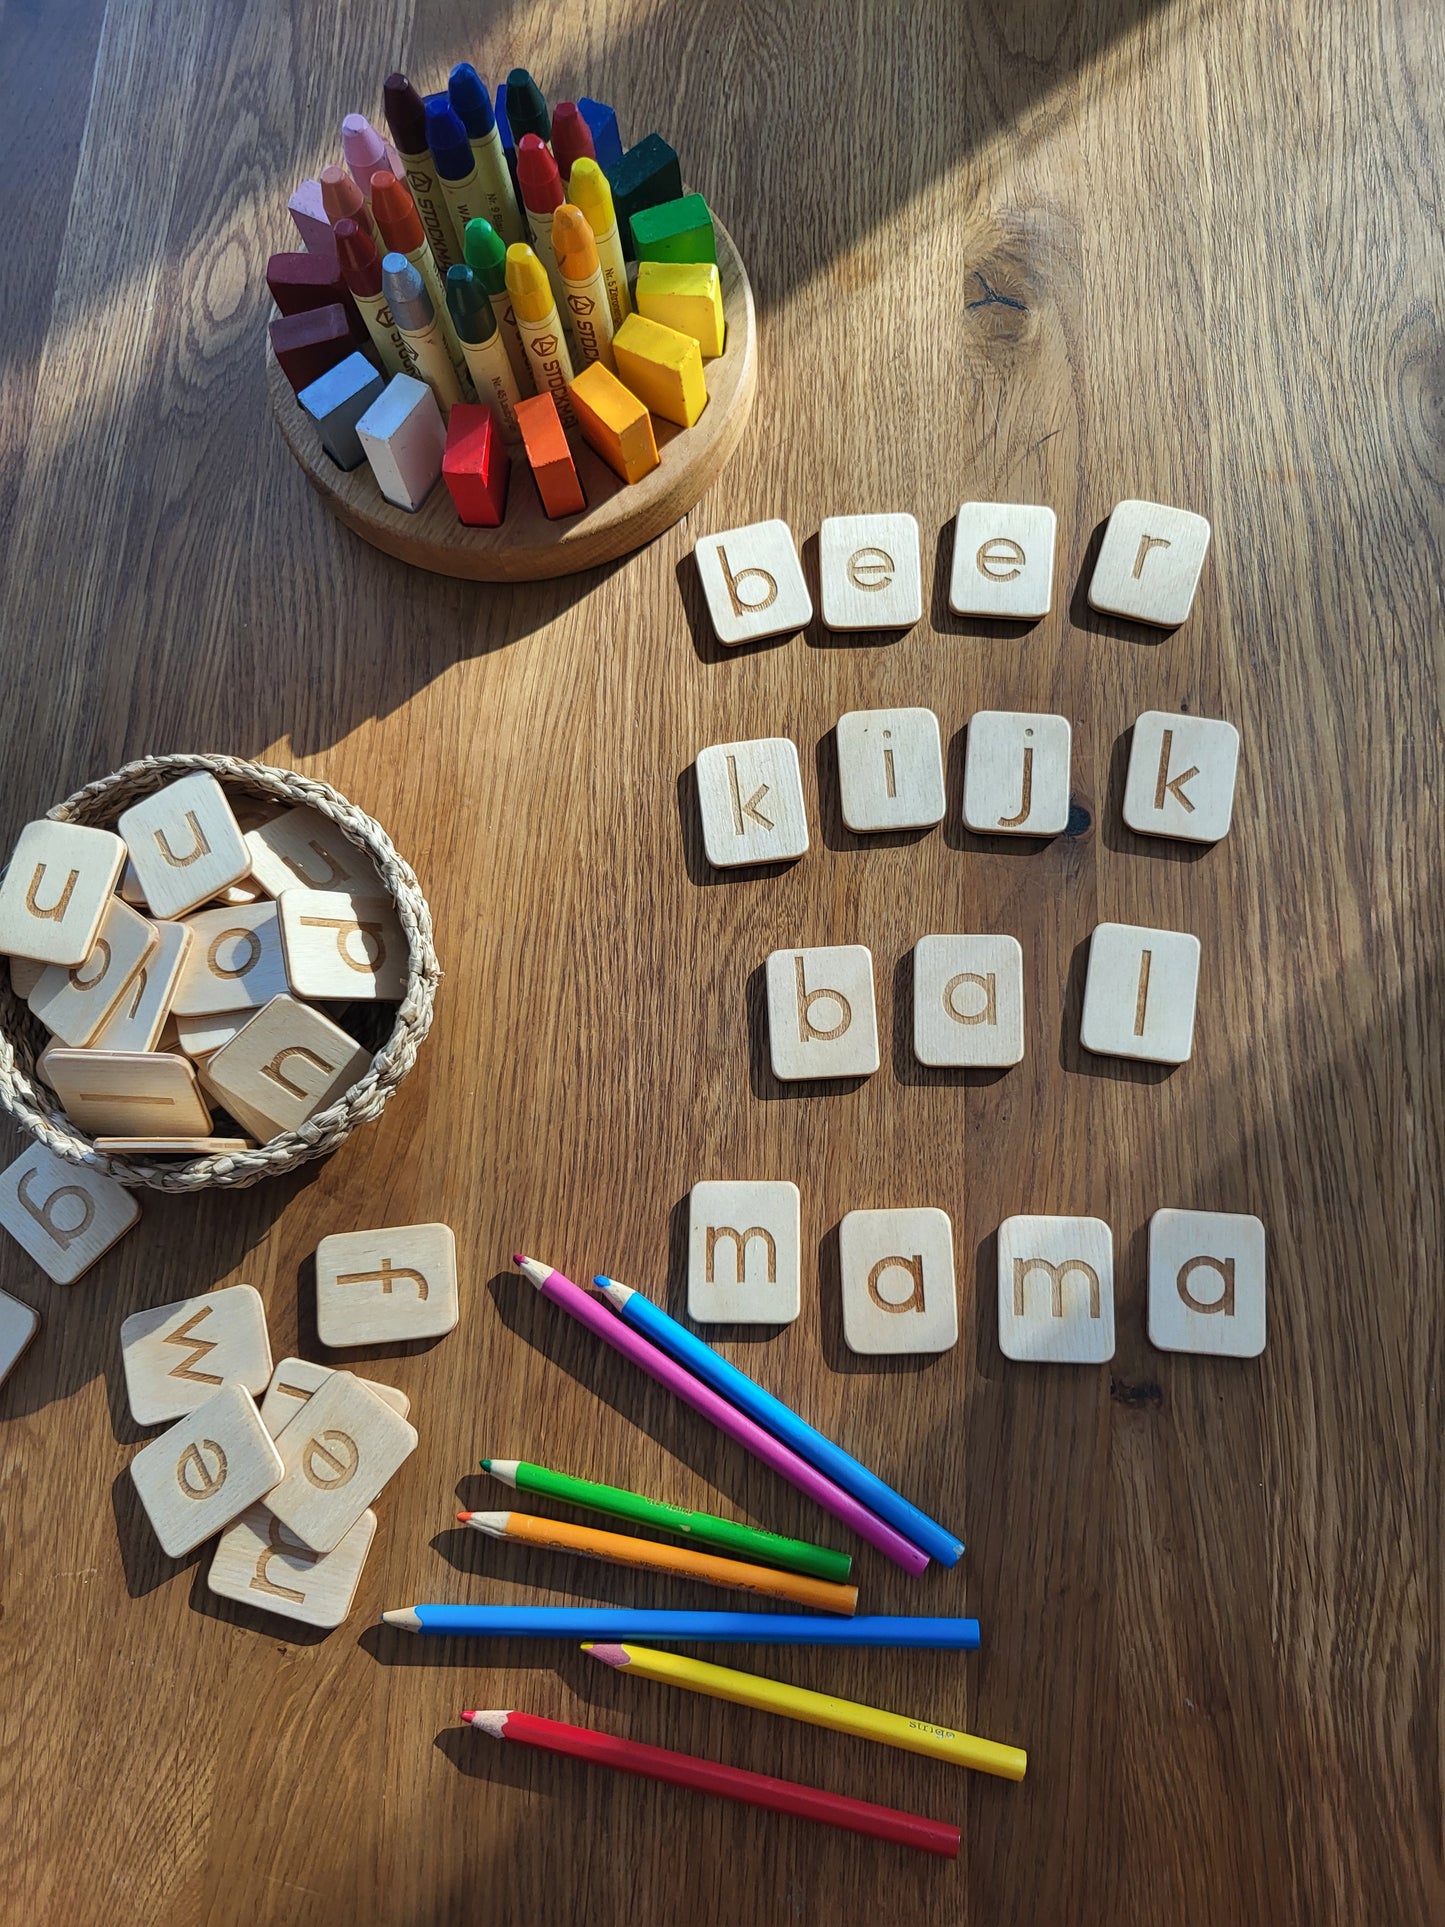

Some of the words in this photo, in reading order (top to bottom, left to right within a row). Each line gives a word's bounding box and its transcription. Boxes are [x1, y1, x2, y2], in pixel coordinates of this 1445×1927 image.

[207, 927, 262, 980] o
[336, 1258, 430, 1301] f
[176, 1438, 229, 1500] e
[303, 1429, 360, 1490] e
